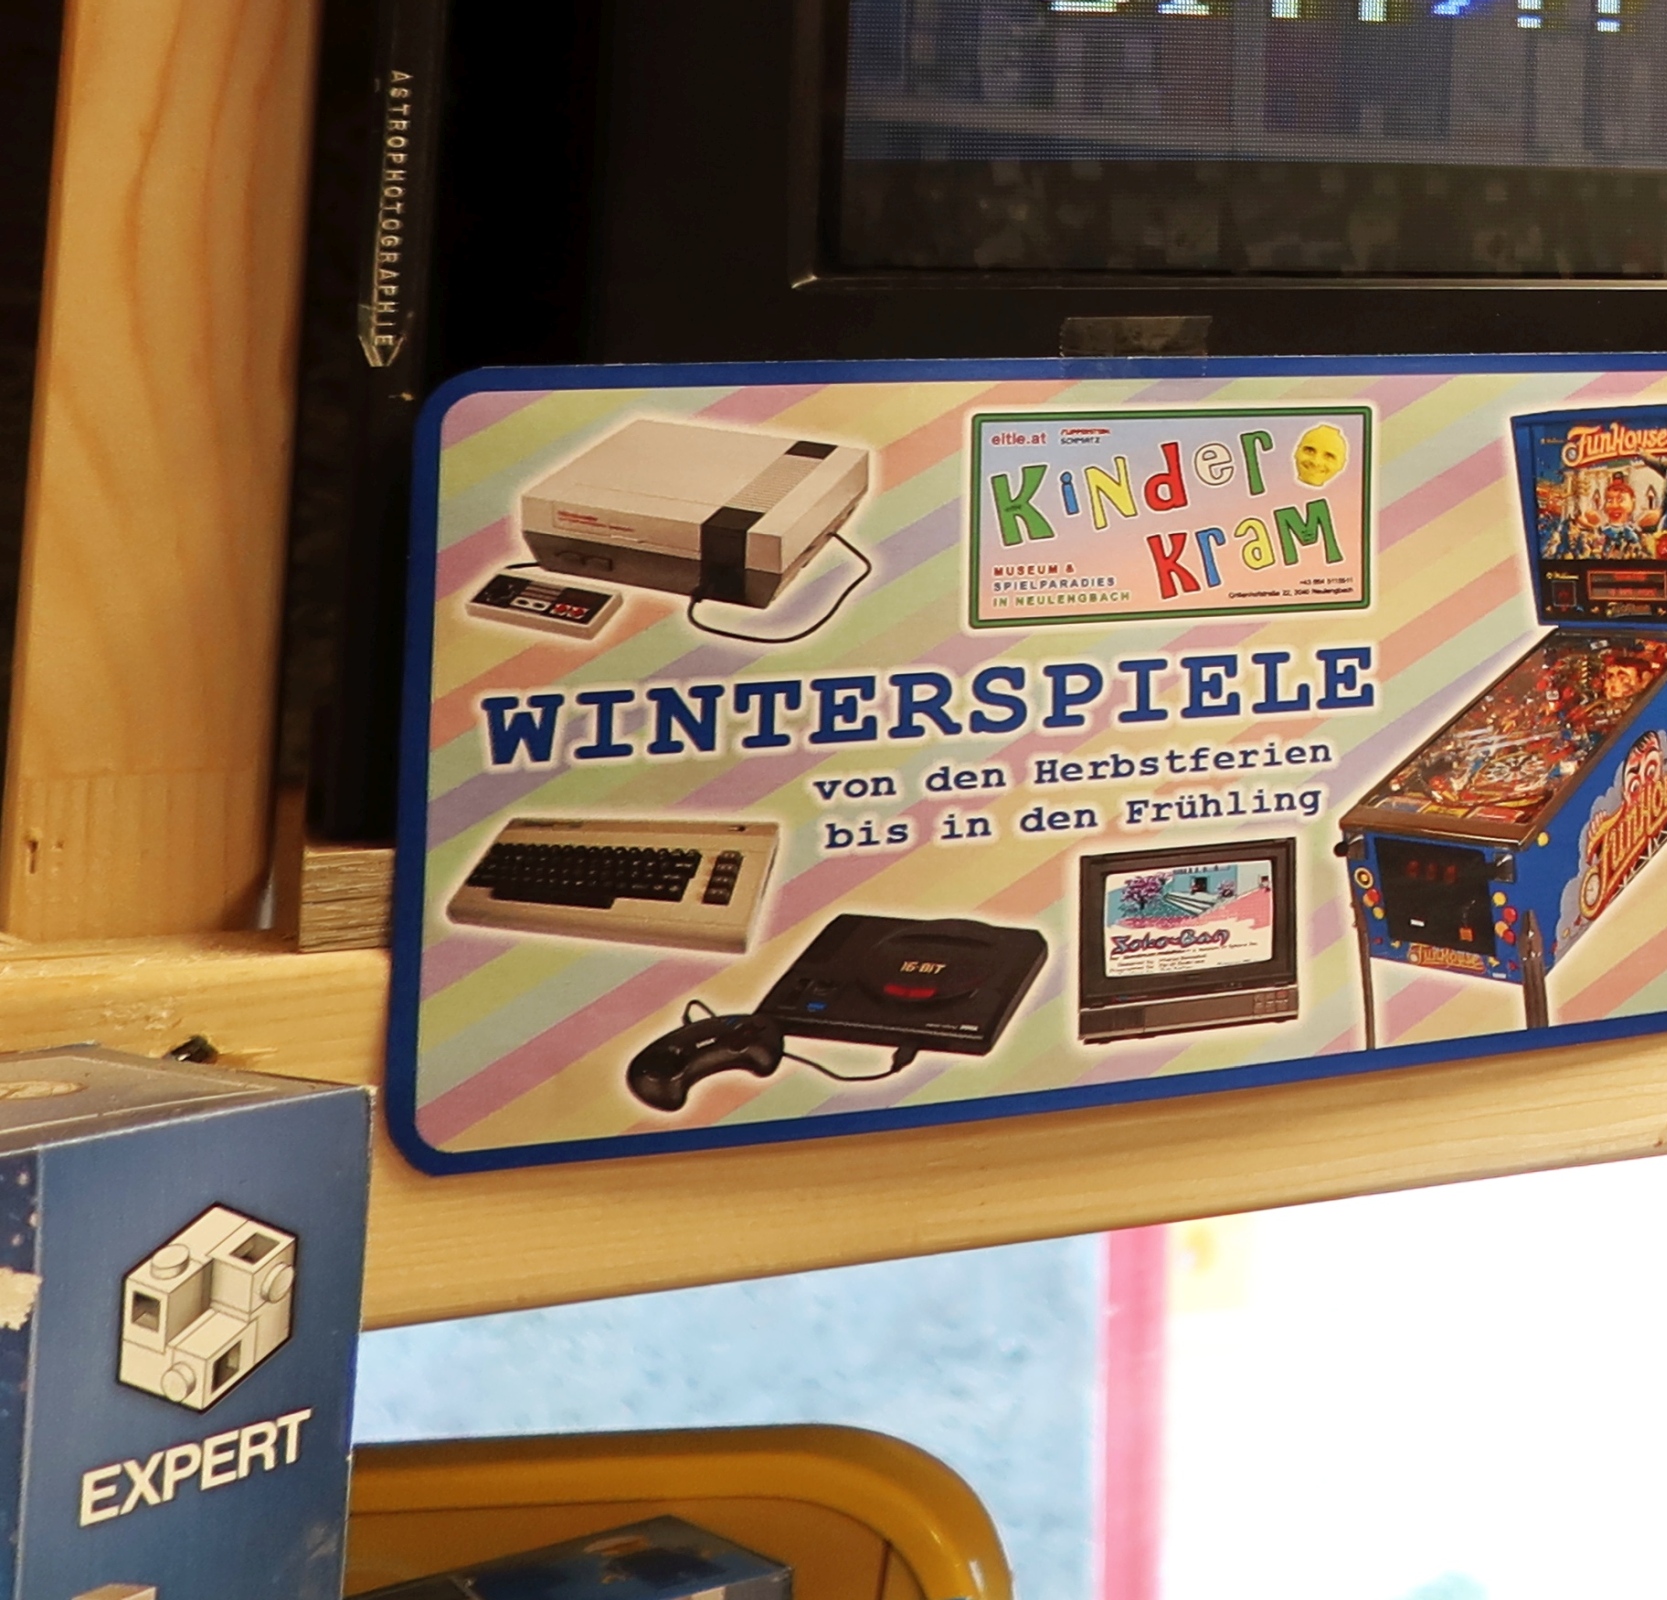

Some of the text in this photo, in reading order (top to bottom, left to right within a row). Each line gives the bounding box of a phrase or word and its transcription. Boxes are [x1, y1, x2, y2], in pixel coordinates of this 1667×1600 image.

[373, 69, 413, 347] ASTROPHOTOGRAPHIE
[993, 564, 1058, 577] MUSEUM
[993, 577, 1116, 592] SPIELPARADIES
[993, 591, 1131, 607] IN NEULENGBACH
[481, 647, 1375, 765] WINTERSPIELE
[813, 740, 1333, 802] von den Herbstferien
[825, 785, 1322, 850] bis in den Frühling
[79, 1408, 312, 1527] EXPERT
